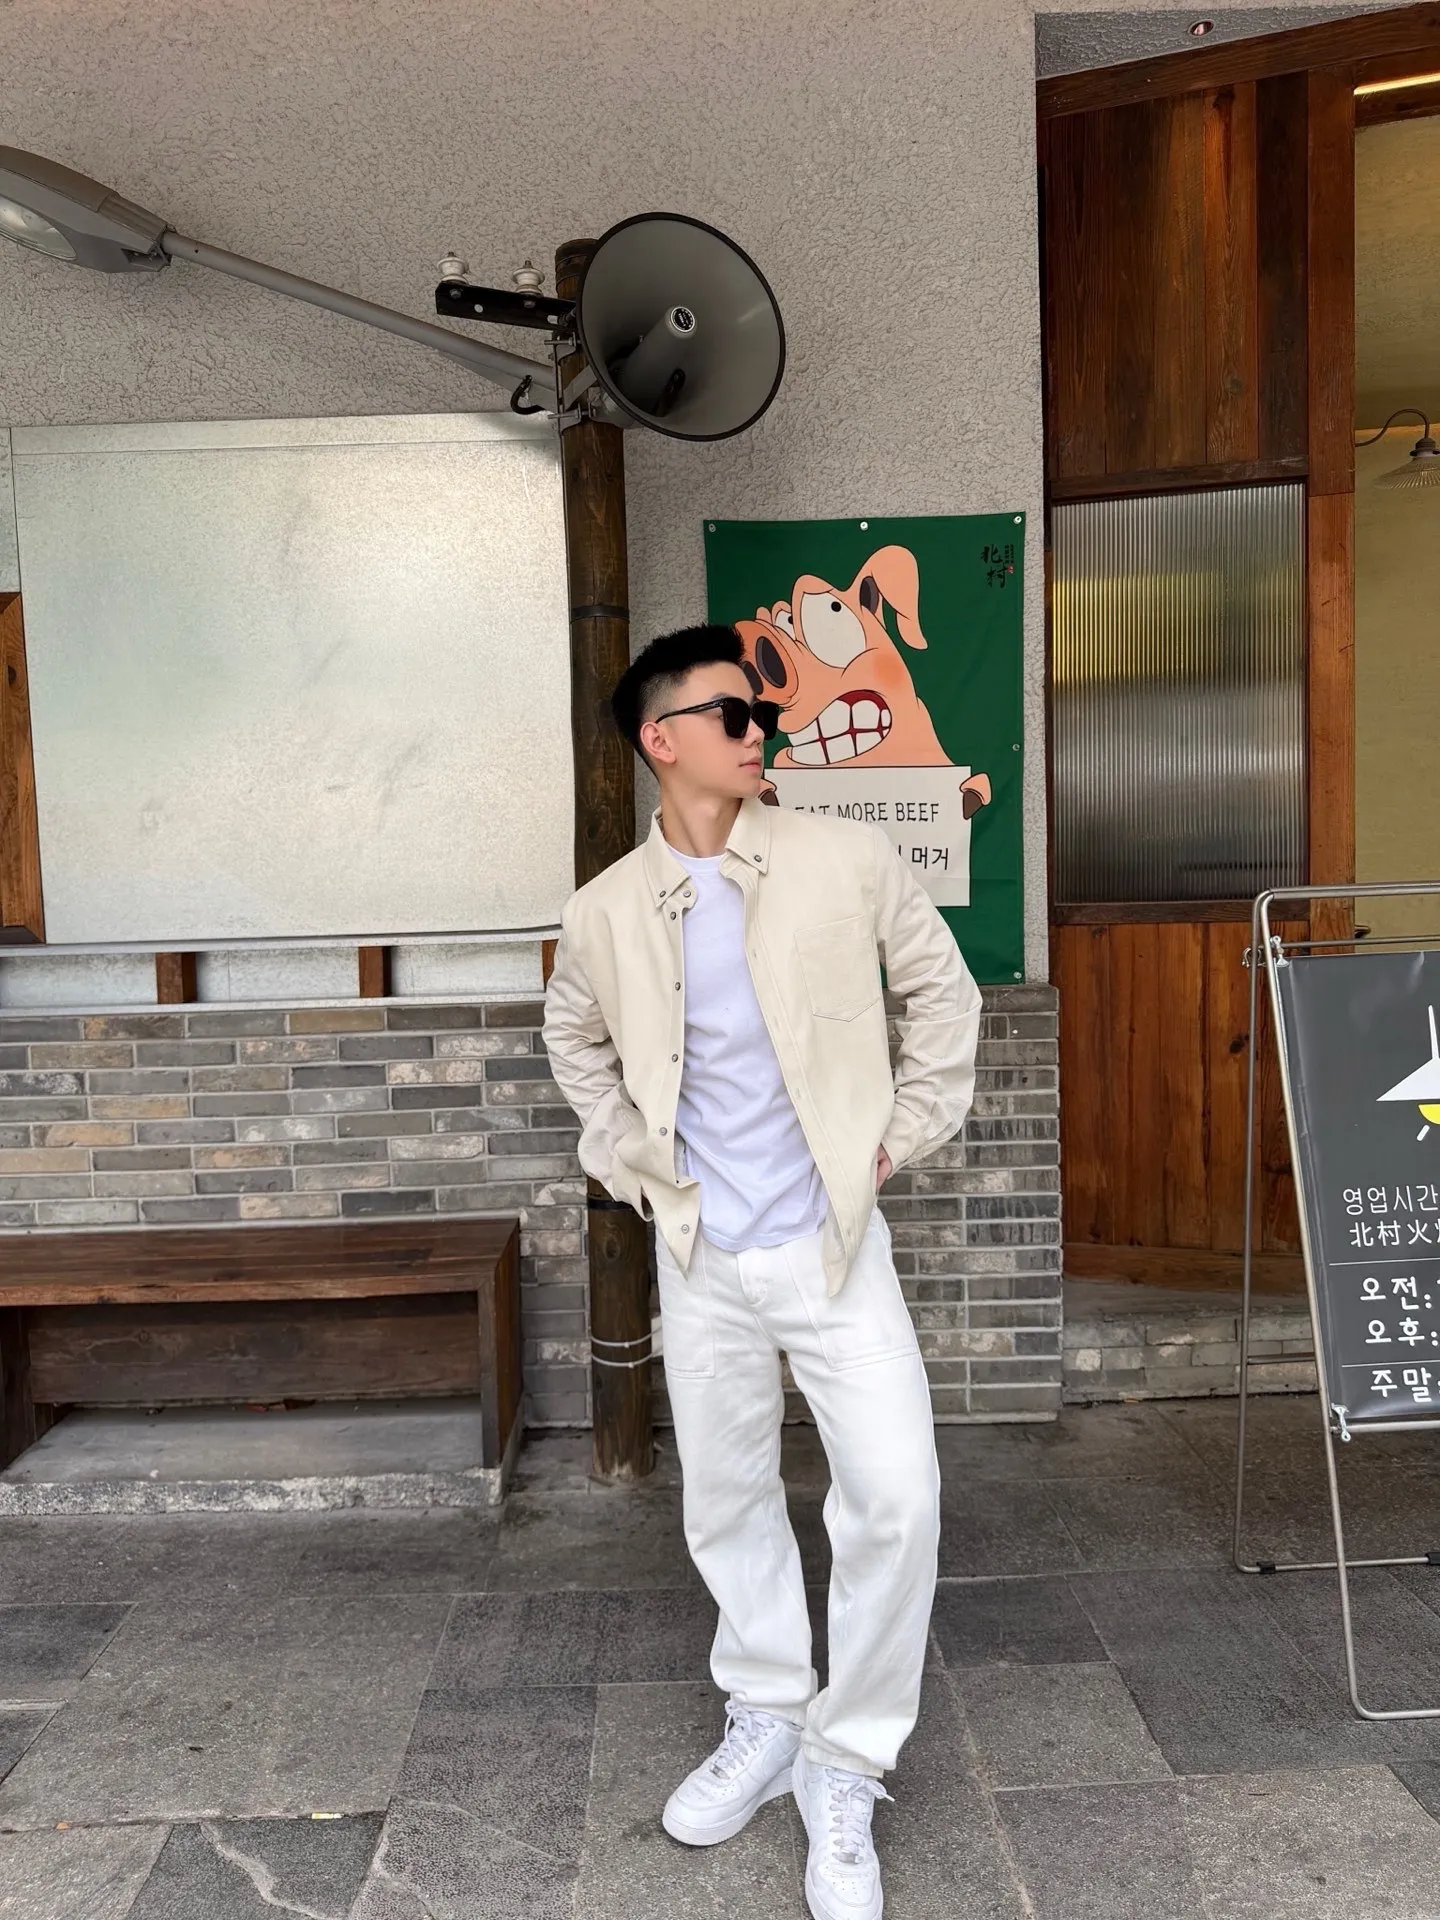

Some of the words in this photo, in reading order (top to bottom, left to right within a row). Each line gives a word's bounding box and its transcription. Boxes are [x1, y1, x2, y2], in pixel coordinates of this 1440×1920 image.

[837, 802, 888, 822] MORE
[895, 802, 939, 823] BEEF
[911, 846, 949, 871] 머거
[1342, 1184, 1439, 1216] 영업시간
[1360, 1276, 1440, 1310] 오전:
